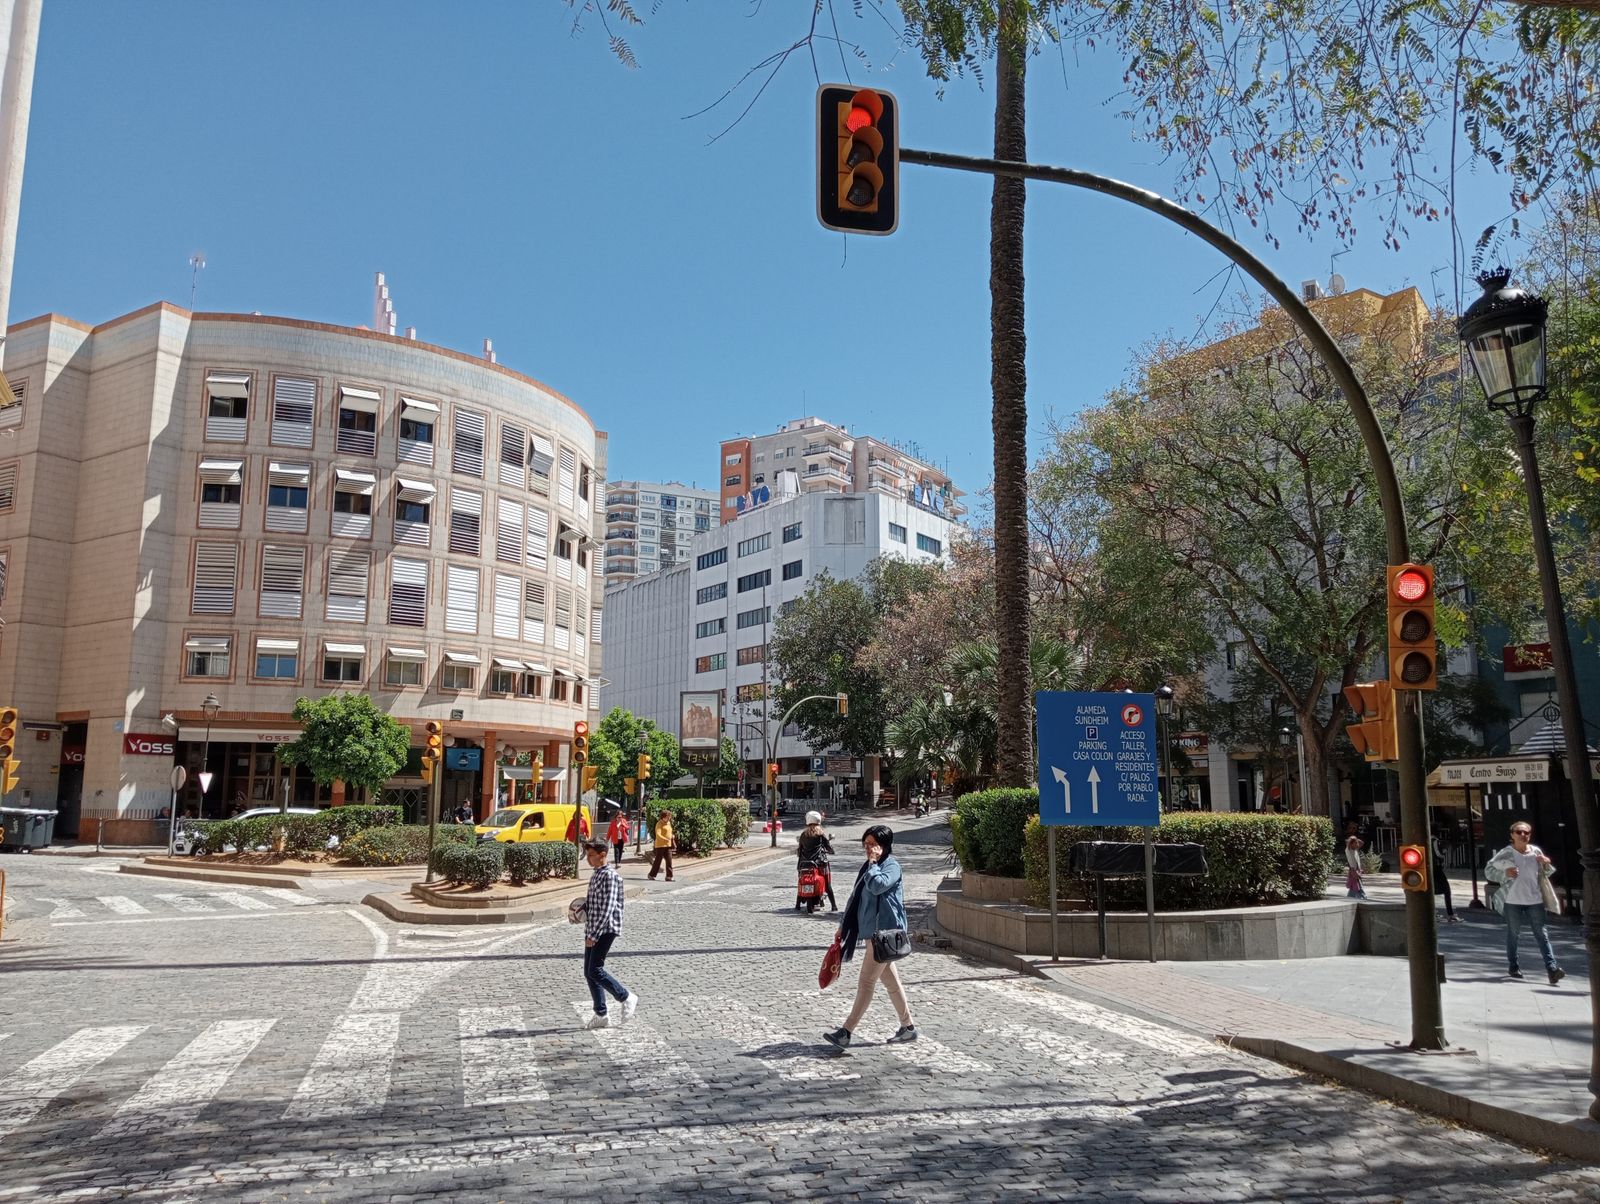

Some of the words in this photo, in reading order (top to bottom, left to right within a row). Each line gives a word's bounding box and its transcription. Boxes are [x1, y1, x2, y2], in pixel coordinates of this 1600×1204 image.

[1076, 705, 1106, 714] ALAMEDA
[1075, 716, 1109, 725] SUNDHEIM
[1089, 728, 1095, 737] P
[1120, 731, 1145, 740] ACCESO
[257, 733, 290, 742] VOSS
[127, 738, 174, 754] VOSS
[1078, 741, 1107, 750] PARKING
[1122, 741, 1147, 751] TALLER,
[1073, 751, 1090, 760] CASA
[1091, 751, 1114, 760] COLON
[1117, 752, 1145, 761] GARAJES
[1145, 752, 1151, 761] Y
[813, 758, 822, 769] P
[1115, 762, 1155, 771] RESIDENTES
[1469, 766, 1492, 778] Centro
[1120, 773, 1128, 782] C/
[1129, 773, 1150, 782] PALOS
[1118, 783, 1132, 792] POR
[1133, 783, 1154, 792] PABLO
